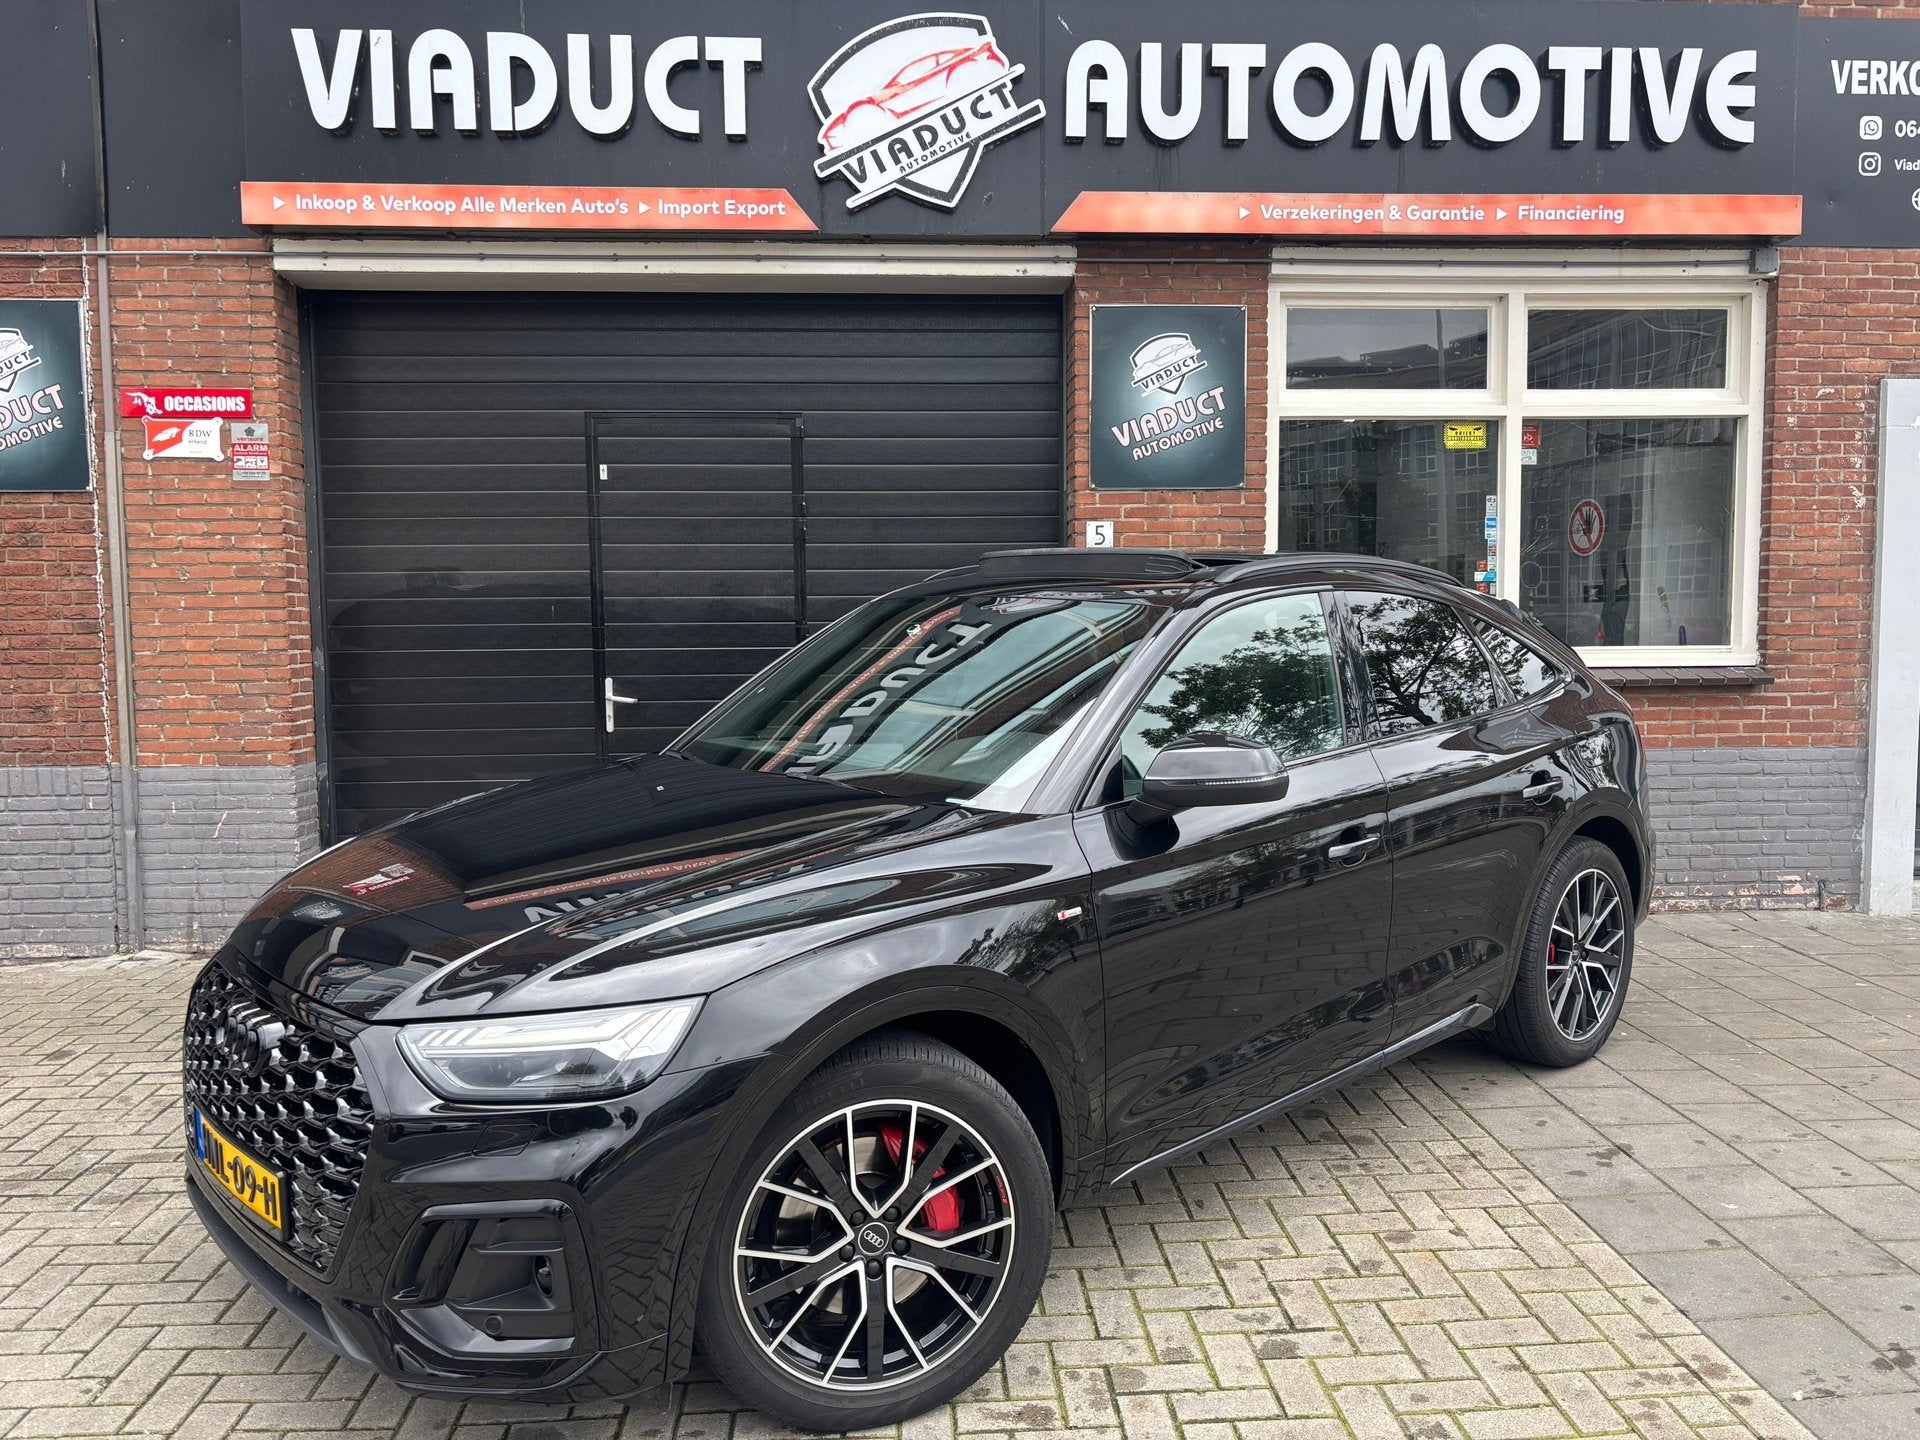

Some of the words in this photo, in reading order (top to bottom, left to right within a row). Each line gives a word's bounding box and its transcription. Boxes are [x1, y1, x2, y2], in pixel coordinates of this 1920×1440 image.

[291, 28, 763, 136] VIADUCT
[1065, 39, 1758, 144] AUTOMOTIVE
[842, 81, 1012, 184] VIADUCT
[899, 131, 972, 174] AUTOMOTIVE
[296, 195, 359, 215] Inkoop
[362, 196, 376, 211] &
[380, 196, 456, 216] Verkoop
[460, 196, 496, 214] Alle
[499, 197, 567, 215] Merken
[571, 198, 629, 215] Auto's
[657, 199, 721, 219] Import
[724, 200, 786, 218] Export
[1260, 203, 1384, 224] Verzekeringen
[1388, 205, 1402, 221] &
[1406, 204, 1485, 222] Garantie
[1517, 204, 1625, 224] Financiering
[1141, 354, 1198, 389] VIADUCT
[164, 395, 246, 412] OCCASIONS
[1111, 386, 1227, 448] VIADUCT
[233, 444, 268, 452] ALARM
[1132, 416, 1225, 461] AUTOMOTIVE
[1094, 525, 1106, 546] 5
